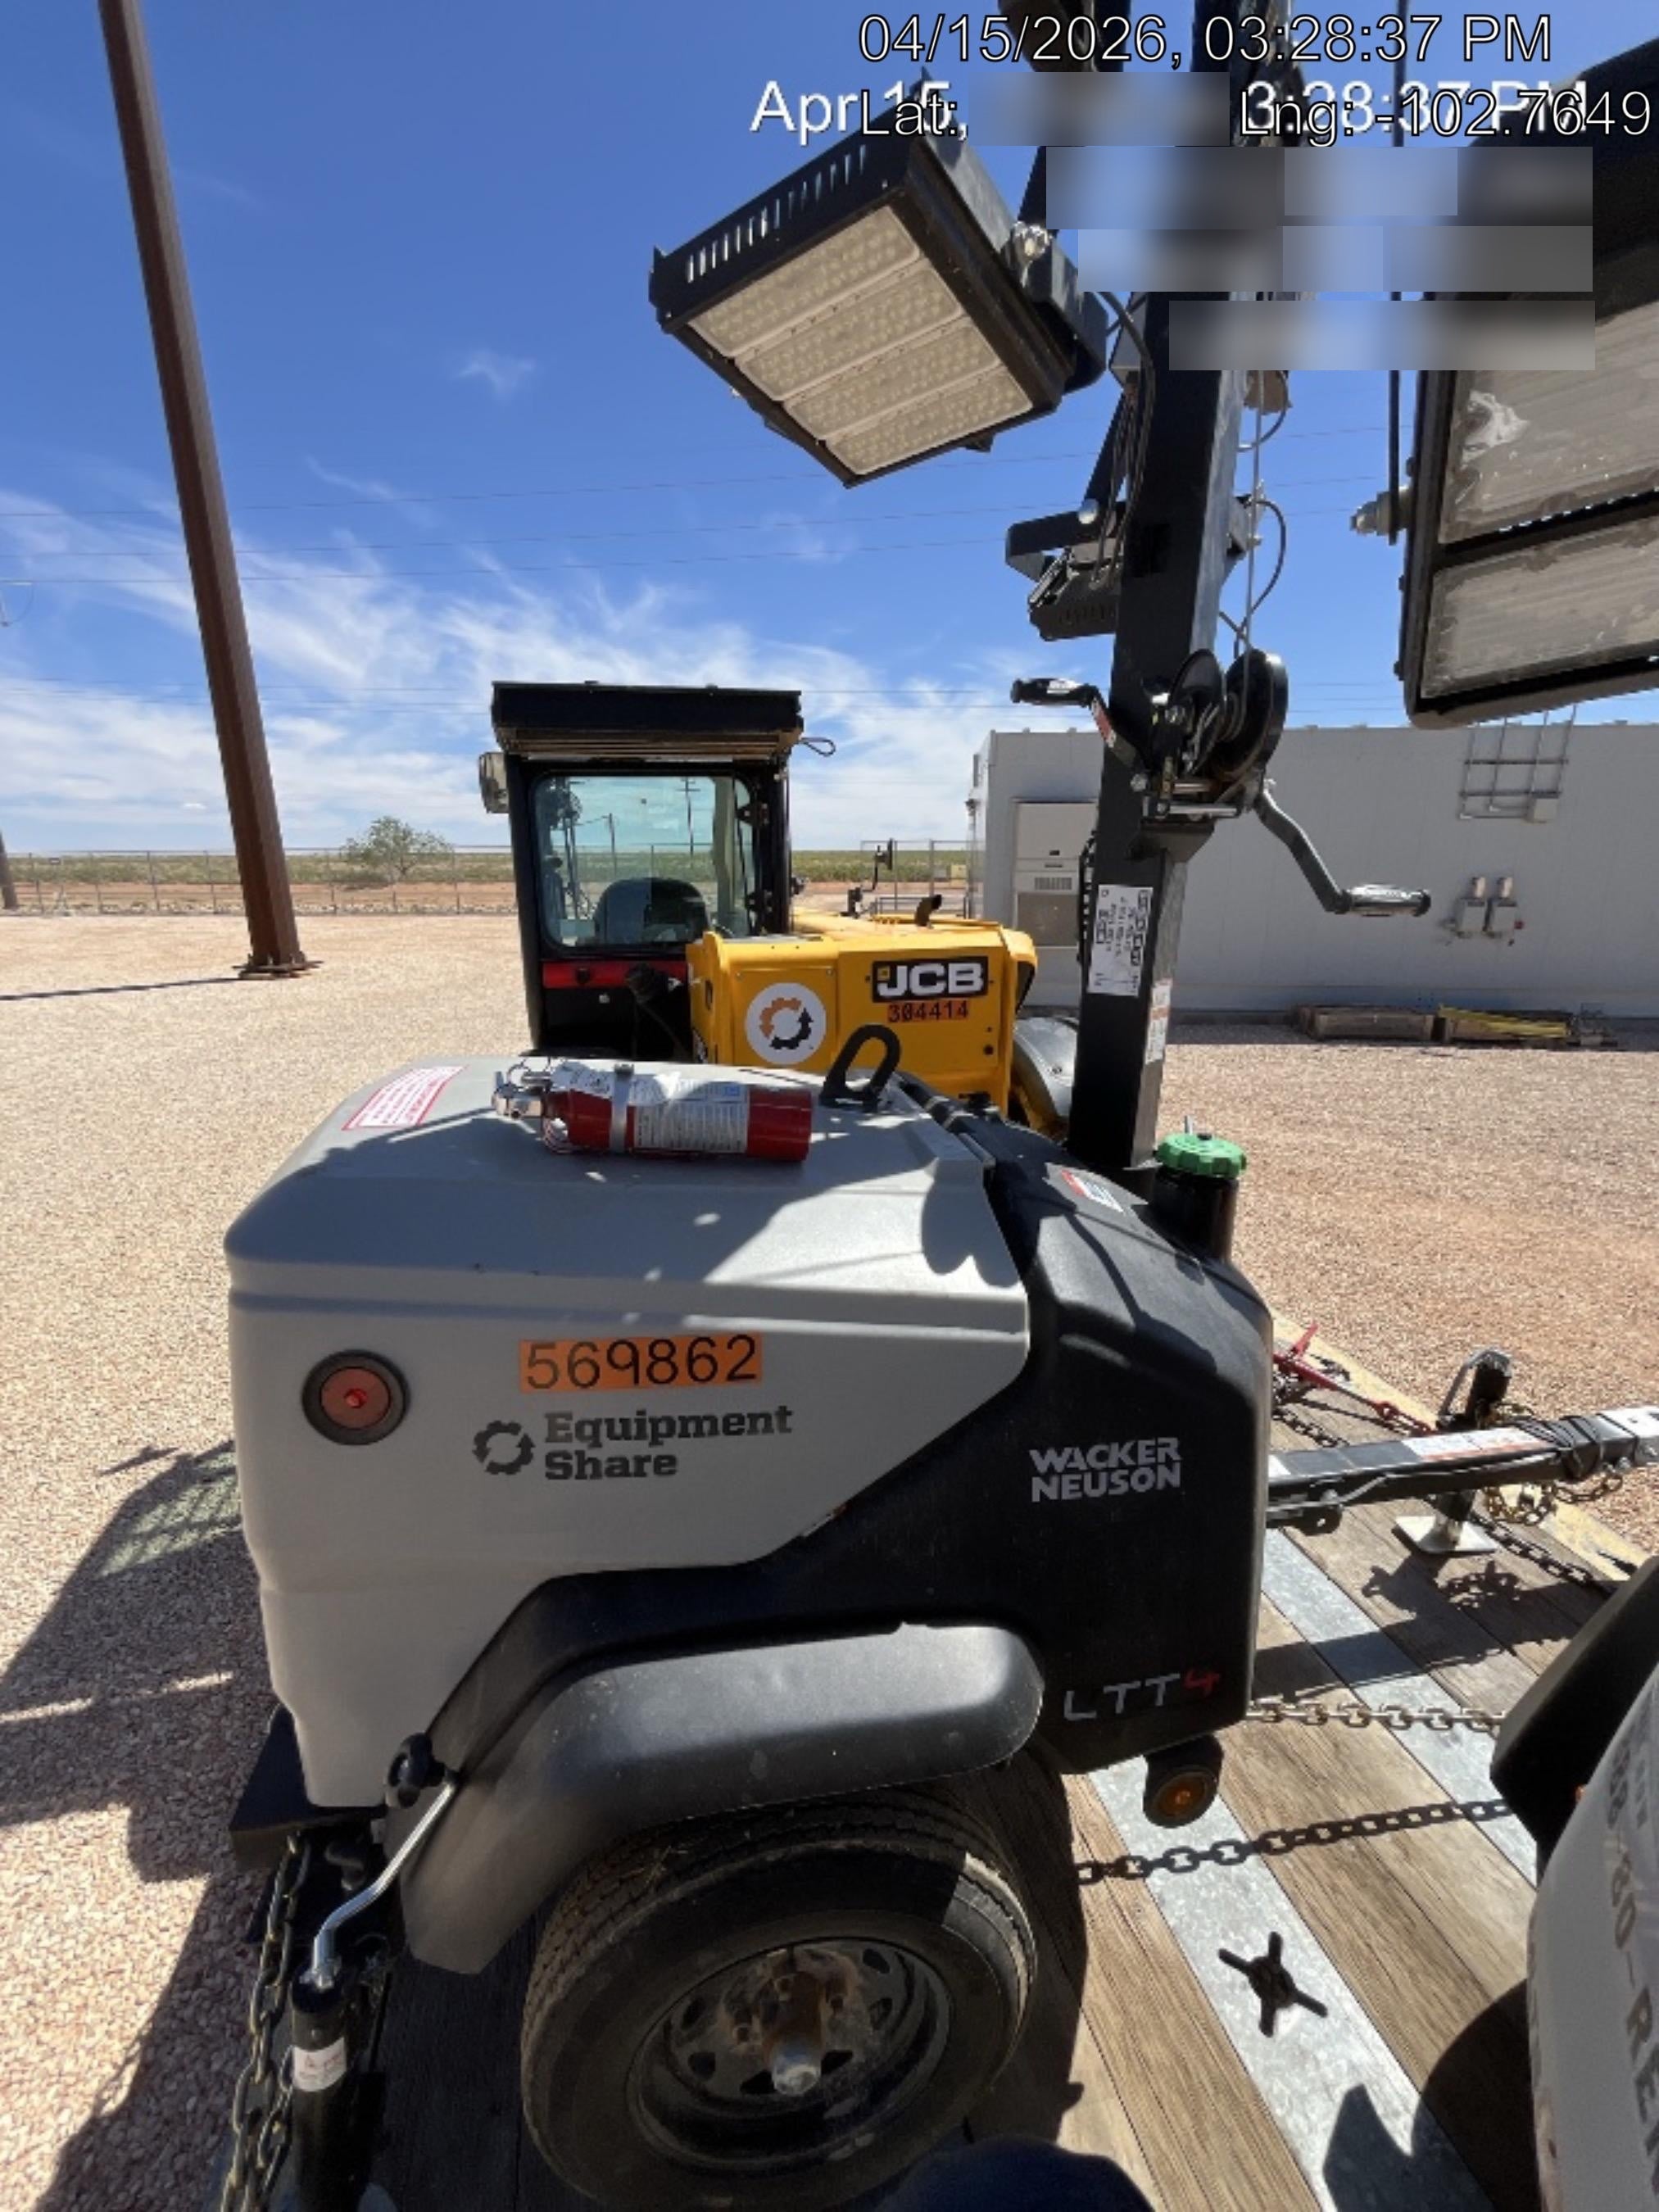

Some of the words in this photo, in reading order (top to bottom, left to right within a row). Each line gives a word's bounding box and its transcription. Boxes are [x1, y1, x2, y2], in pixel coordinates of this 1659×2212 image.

[877, 963, 984, 997] JCB
[527, 1335, 757, 1389] 569862
[544, 1405, 793, 1448] Equipment
[544, 1449, 678, 1480] Share
[1029, 1437, 1182, 1474] WACKER
[1031, 1462, 1181, 1503] NEUSON
